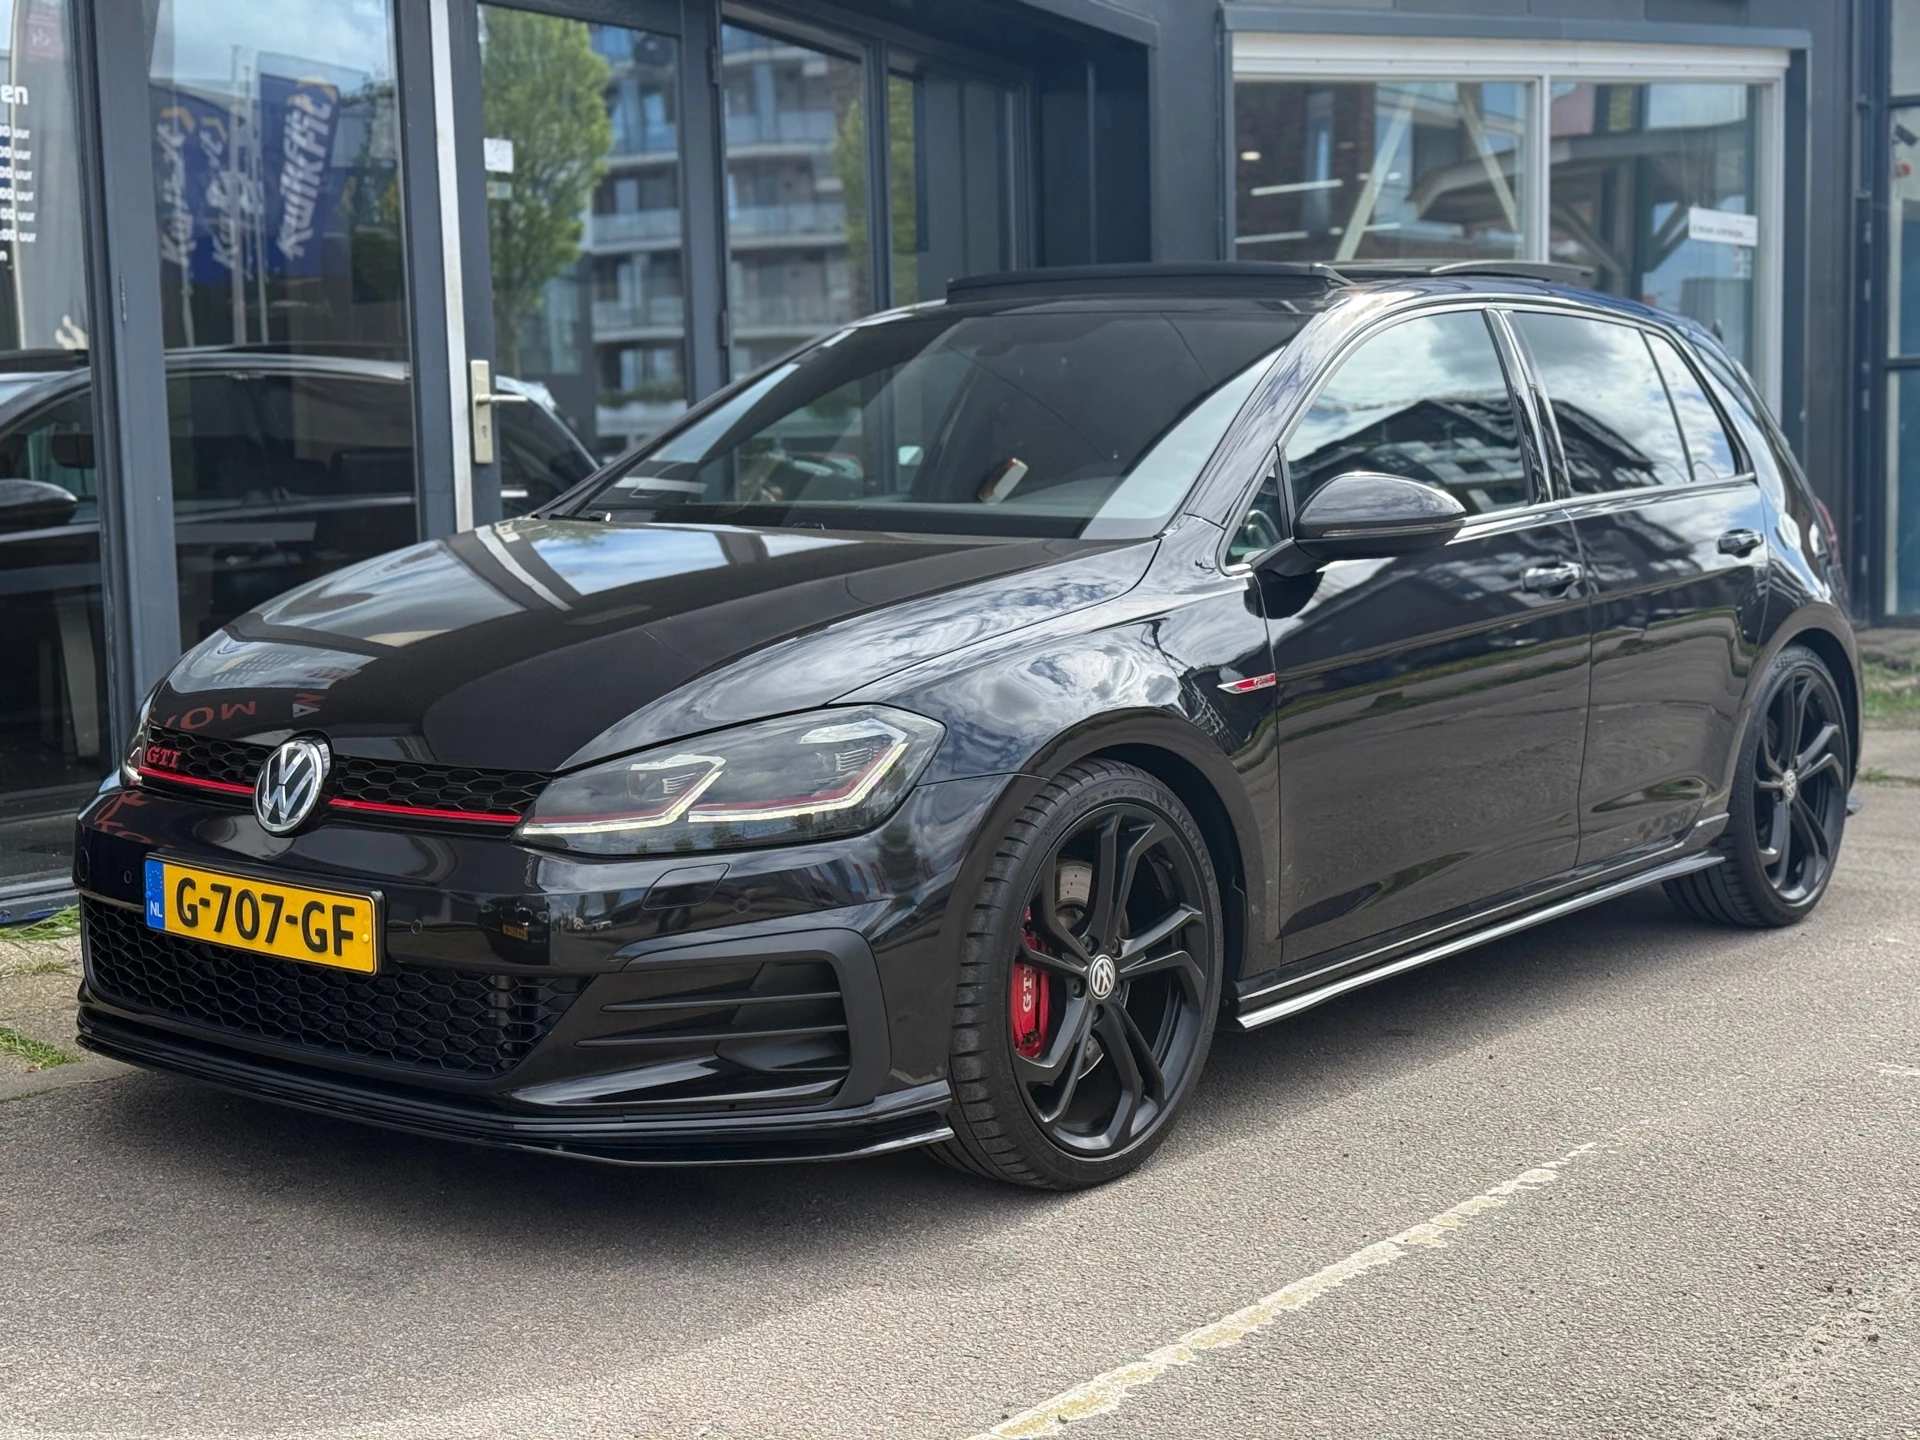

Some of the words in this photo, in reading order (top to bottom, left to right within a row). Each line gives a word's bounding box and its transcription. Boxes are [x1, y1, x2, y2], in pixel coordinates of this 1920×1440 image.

[147, 746, 181, 769] GTI
[150, 900, 163, 919] NL
[176, 877, 355, 956] G-707-GF
[1022, 965, 1033, 1012] GTI
